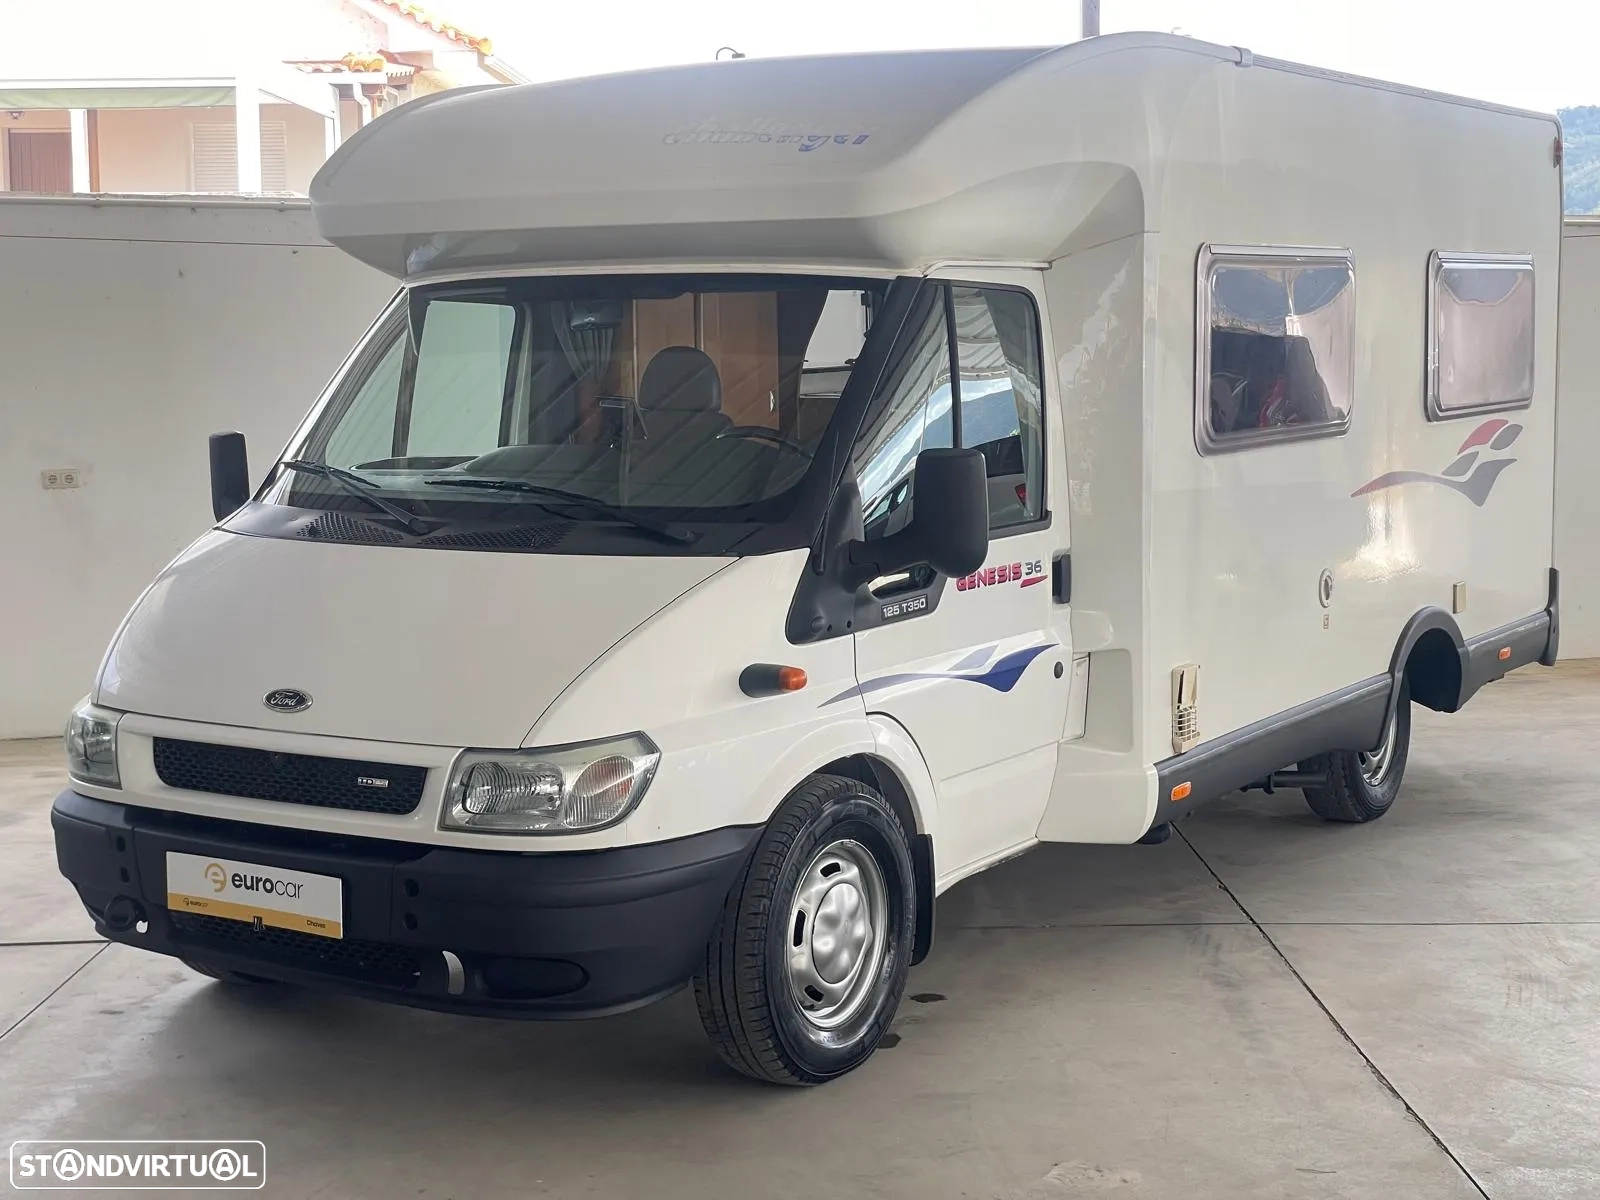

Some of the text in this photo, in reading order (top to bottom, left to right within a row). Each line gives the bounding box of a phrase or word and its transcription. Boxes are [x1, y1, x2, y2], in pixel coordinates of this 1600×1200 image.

[956, 560, 1042, 592] GENESIS 36
[883, 599, 926, 618] 125 T350
[270, 691, 300, 706] Ford
[231, 873, 304, 899] eurocar
